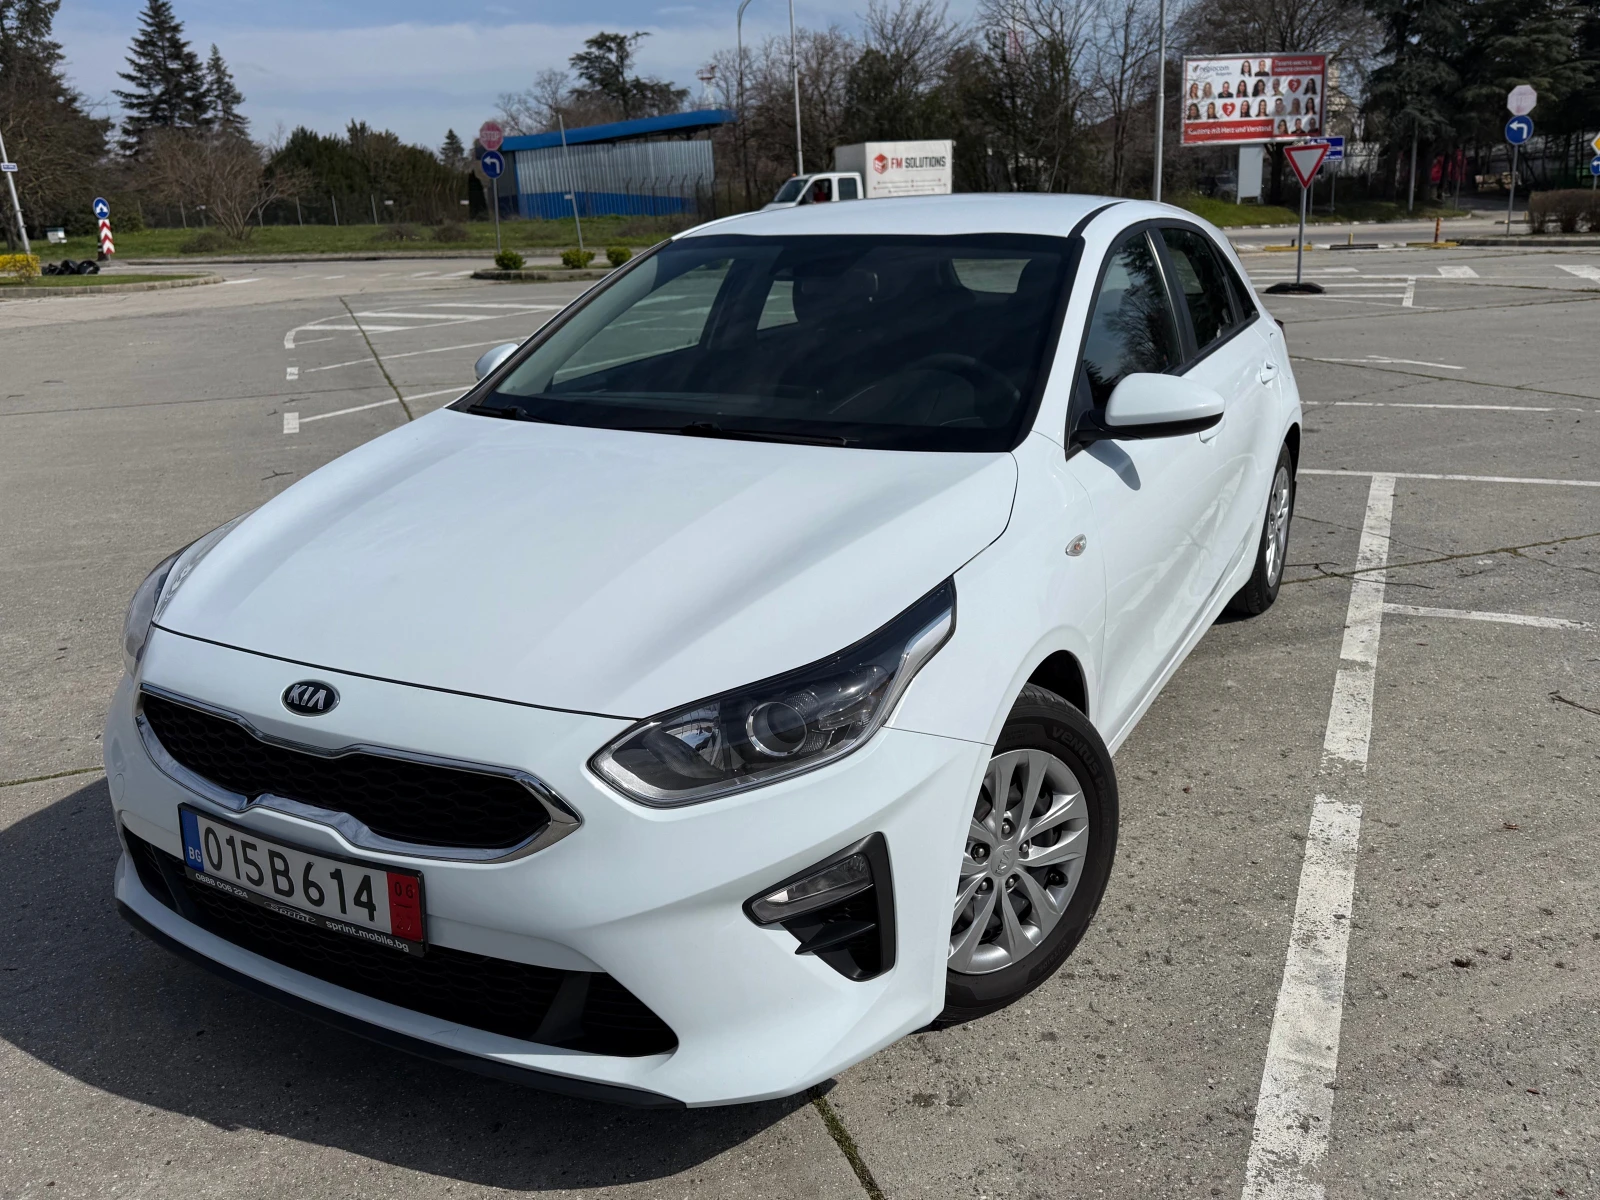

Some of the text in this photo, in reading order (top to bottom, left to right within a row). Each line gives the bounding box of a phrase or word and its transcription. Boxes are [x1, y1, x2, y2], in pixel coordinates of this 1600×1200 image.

[481, 130, 501, 141] STOP
[1221, 126, 1235, 134] Herz
[890, 155, 946, 169] FM SOLUTIONS
[286, 683, 327, 710] KIA
[188, 846, 202, 863] BG
[204, 826, 377, 922] 015B614
[394, 881, 414, 899] 06
[325, 919, 410, 953] sprint.mobile.bg
